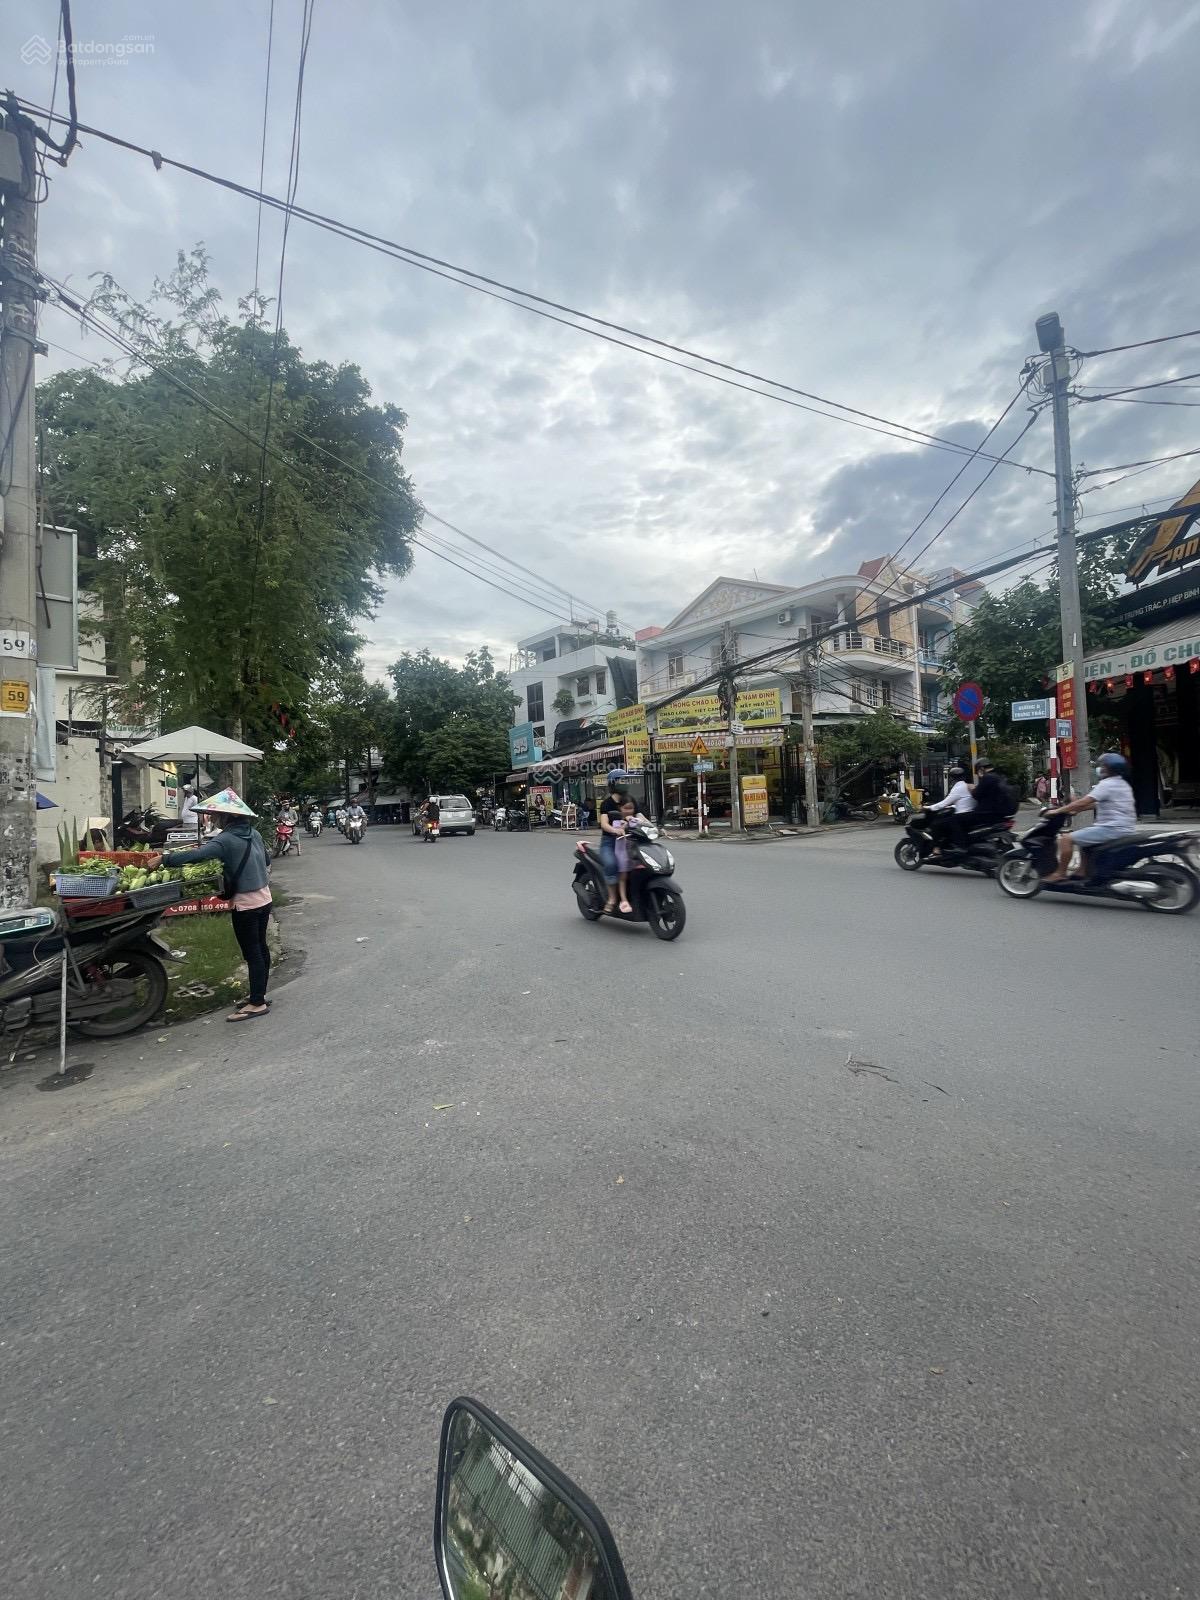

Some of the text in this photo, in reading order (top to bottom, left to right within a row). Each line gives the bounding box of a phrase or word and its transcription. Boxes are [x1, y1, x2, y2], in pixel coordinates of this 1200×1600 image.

[3, 638, 25, 651] 59
[8, 690, 25, 702] 59
[178, 904, 198, 912] 0708
